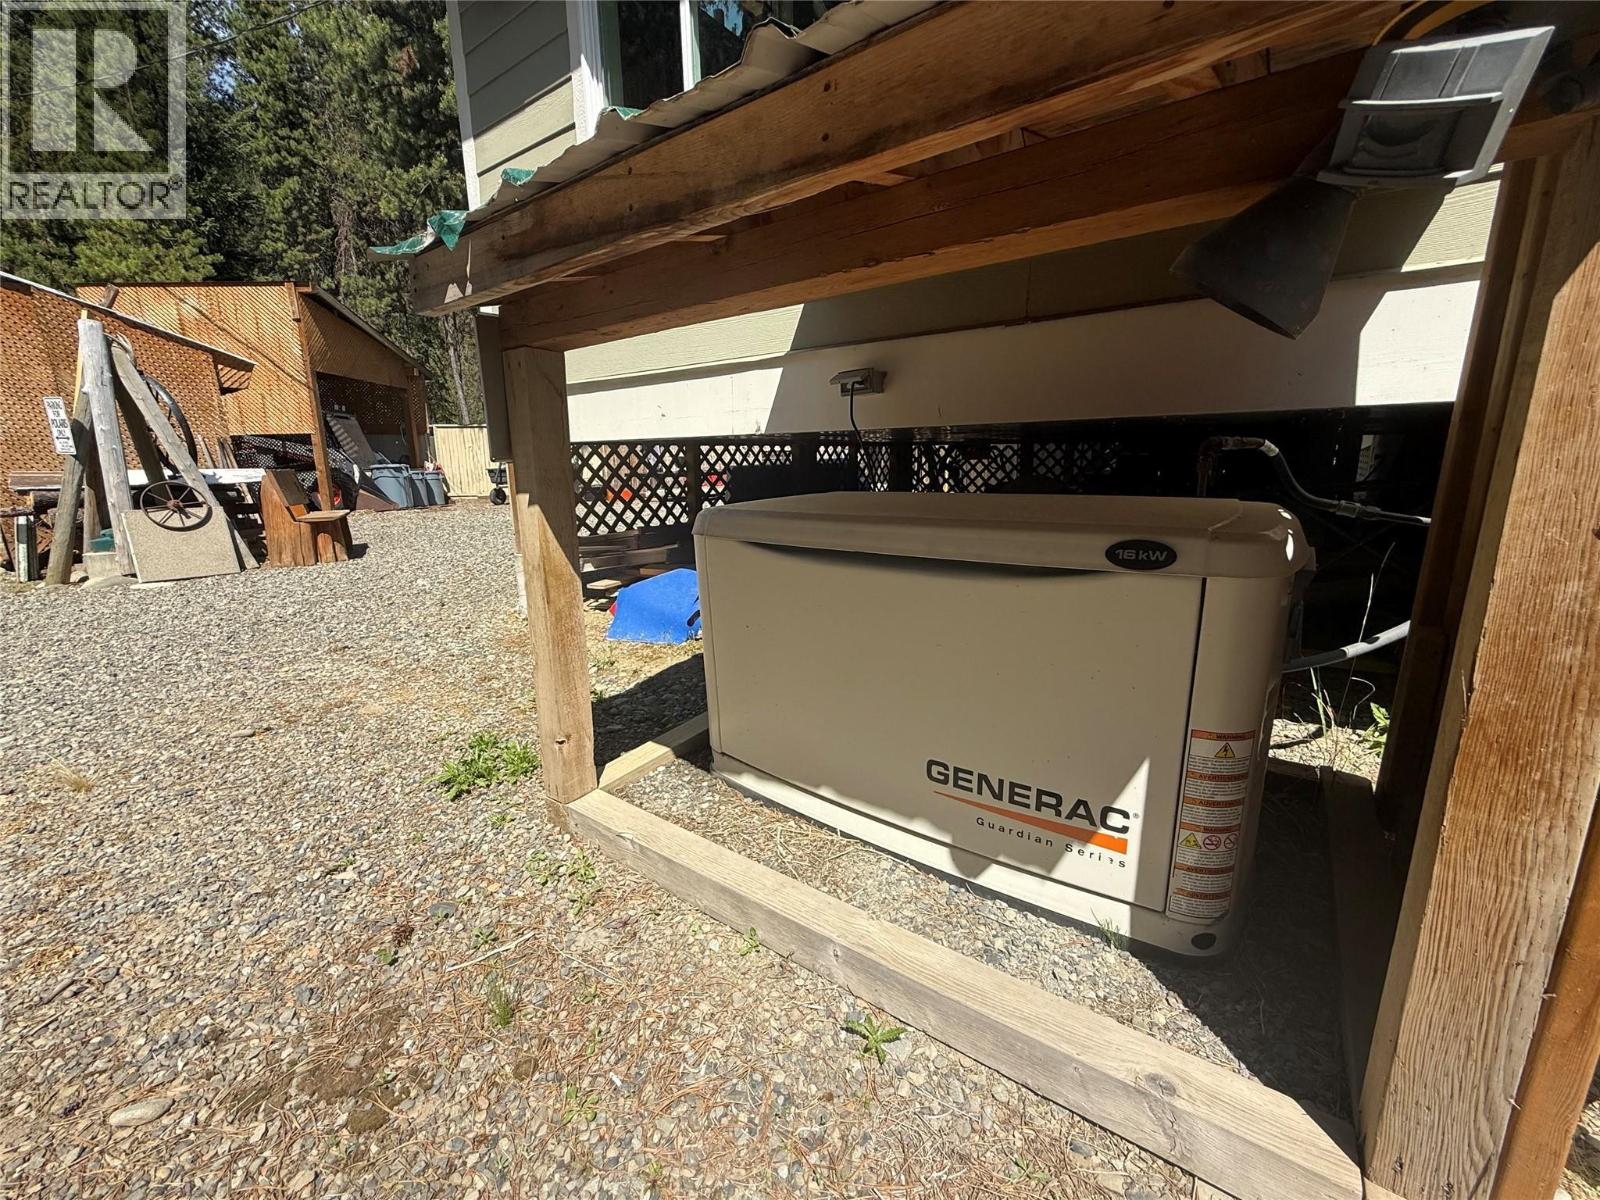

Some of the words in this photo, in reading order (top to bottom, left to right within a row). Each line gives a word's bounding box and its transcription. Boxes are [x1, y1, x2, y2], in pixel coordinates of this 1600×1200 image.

[50, 418, 68, 429] POLARIS
[1115, 549, 1136, 560] 16
[1138, 550, 1168, 561] kW
[926, 759, 1130, 834] GENERAC
[976, 817, 1053, 847] Guardian
